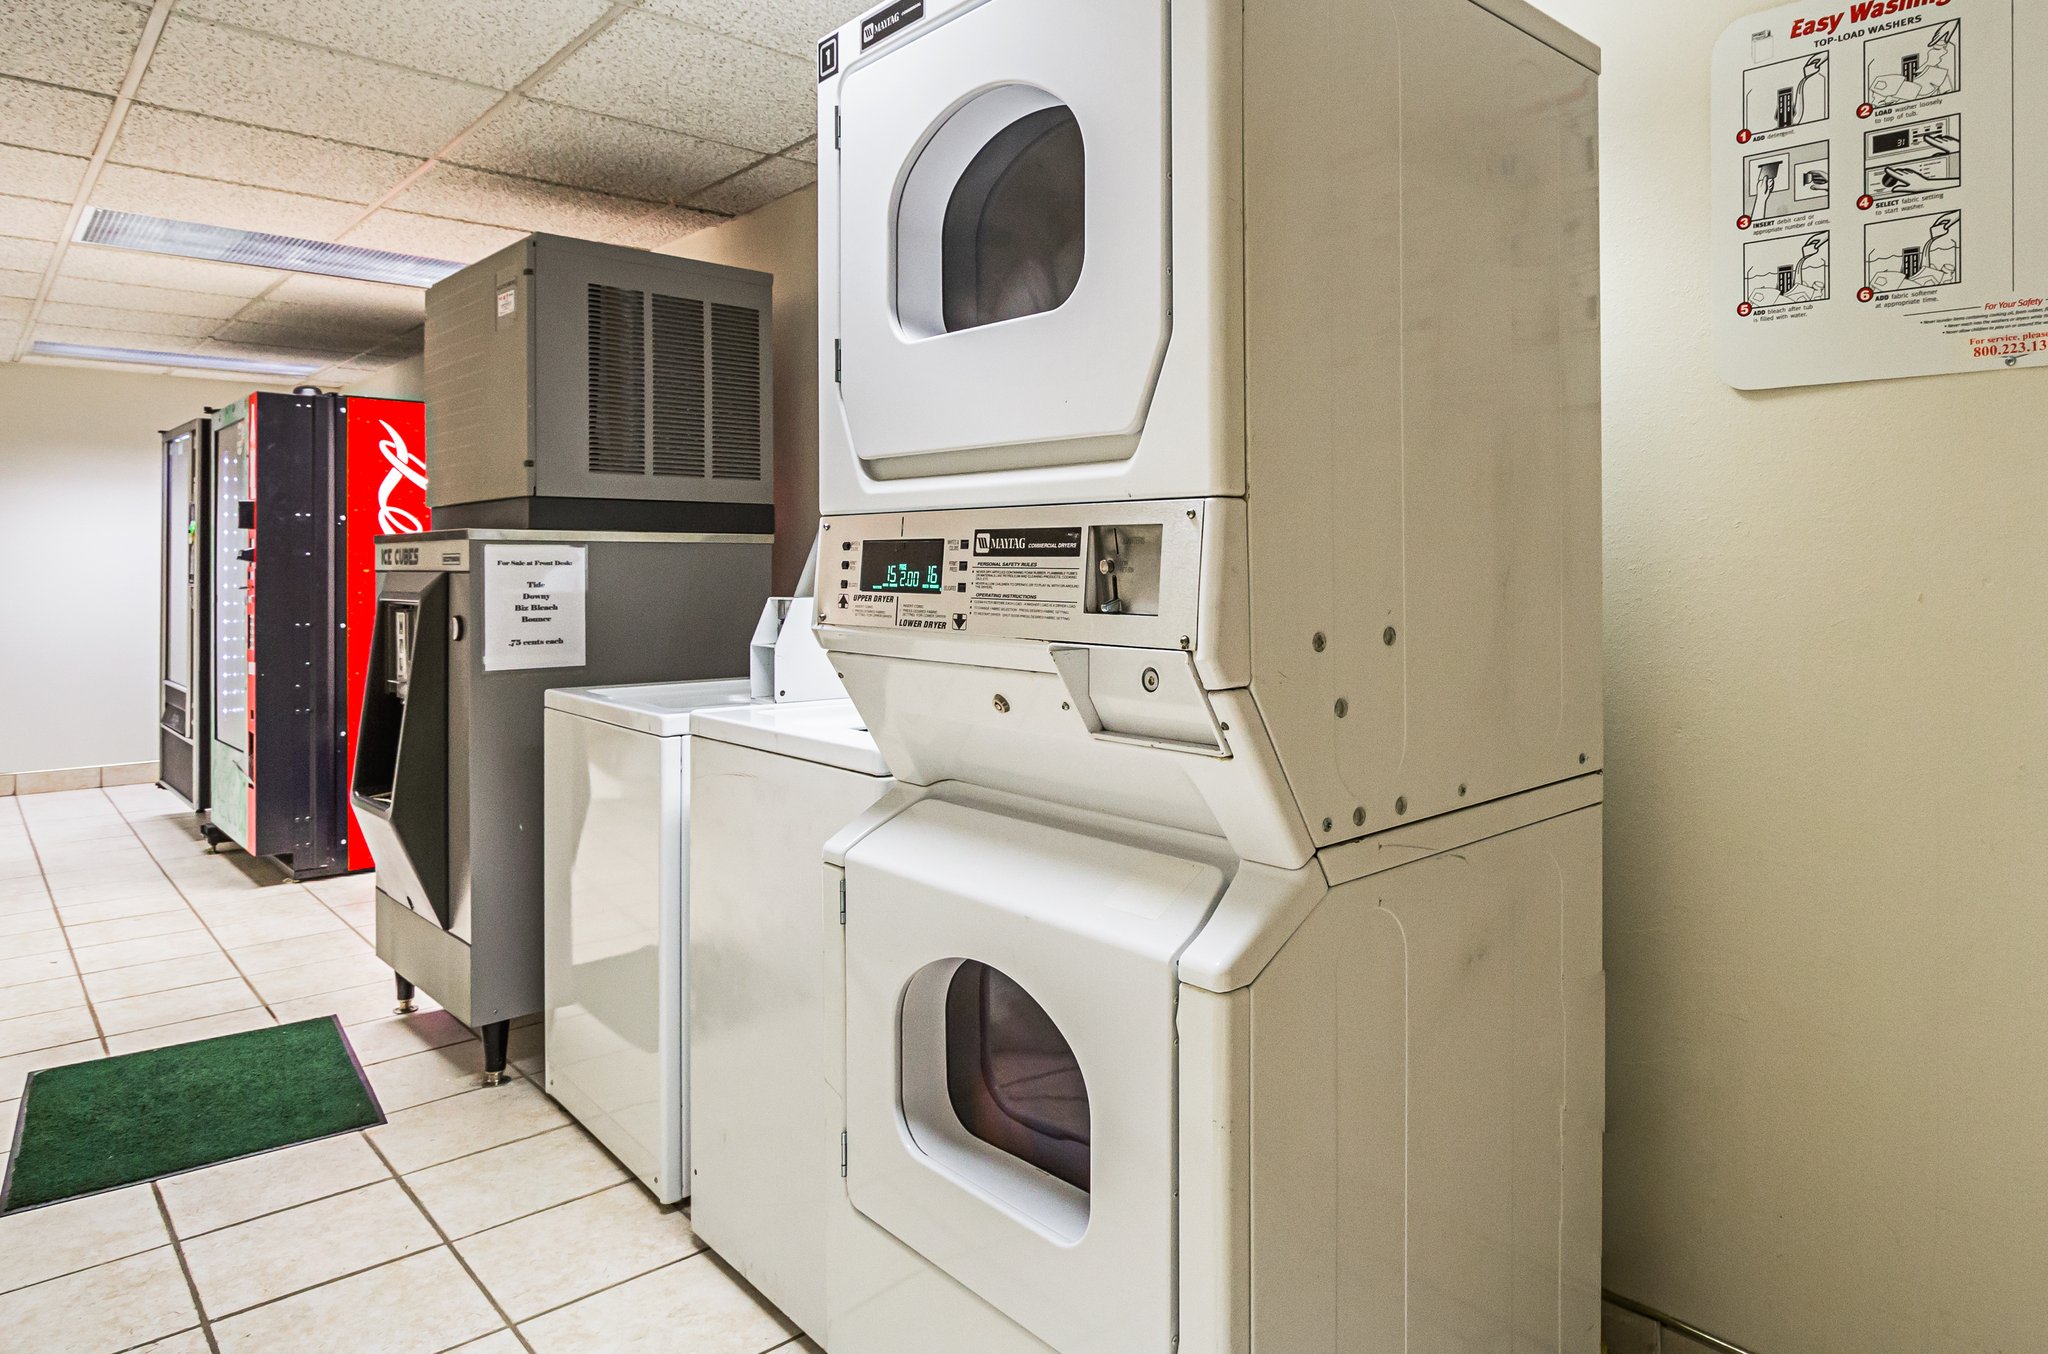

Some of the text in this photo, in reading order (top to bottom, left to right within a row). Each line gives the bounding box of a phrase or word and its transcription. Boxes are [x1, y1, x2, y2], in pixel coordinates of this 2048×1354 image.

[874, 12, 899, 34] MAYTAG
[1790, 12, 1845, 39] Easy
[1814, 15, 1922, 48] TOP-LOAD WASHERS
[826, 49, 830, 66] 1
[1860, 106, 1870, 117] 2
[1875, 109, 1892, 117] LOAD
[1920, 98, 1943, 108] loosely
[1859, 197, 1869, 208] 4
[1876, 200, 1899, 208] SELECT
[1922, 193, 1944, 201] setting
[1740, 218, 1749, 228] 3
[1860, 290, 1870, 300] 6
[1741, 305, 1749, 315] 5
[1999, 301, 2017, 309] Your
[2018, 298, 2043, 307] Safety
[991, 538, 1026, 549] MAYTAG
[381, 548, 419, 565] ICE CUBES
[887, 565, 897, 582] 15
[900, 571, 920, 587] 2.00
[928, 566, 938, 584] 16
[523, 593, 550, 601] Downy
[854, 594, 894, 603] UPPER DRYER
[899, 619, 947, 630] LOWER DRYER
